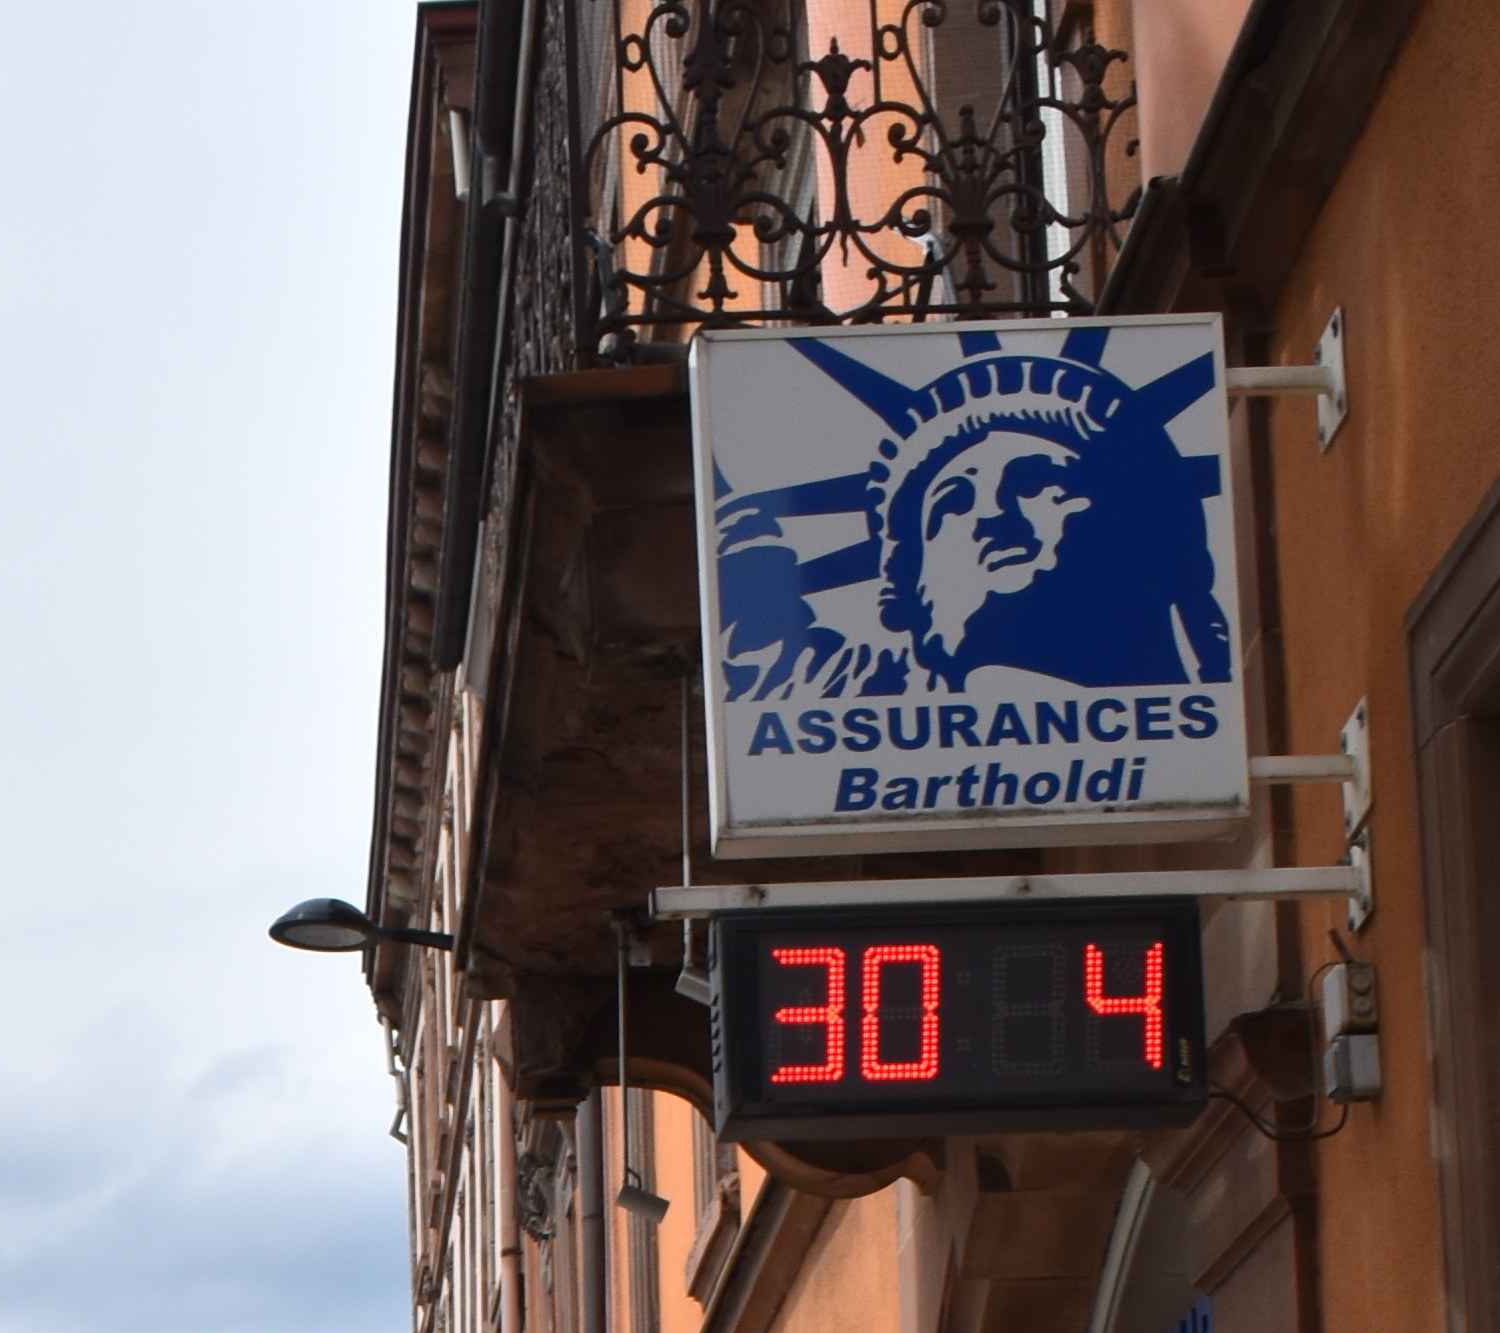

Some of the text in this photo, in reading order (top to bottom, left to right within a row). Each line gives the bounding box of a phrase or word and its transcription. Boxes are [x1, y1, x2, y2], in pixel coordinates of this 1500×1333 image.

[747, 695, 1219, 757] ASSURANCES
[834, 756, 1147, 813] Bartholdi
[771, 942, 1163, 1082] 30 4
